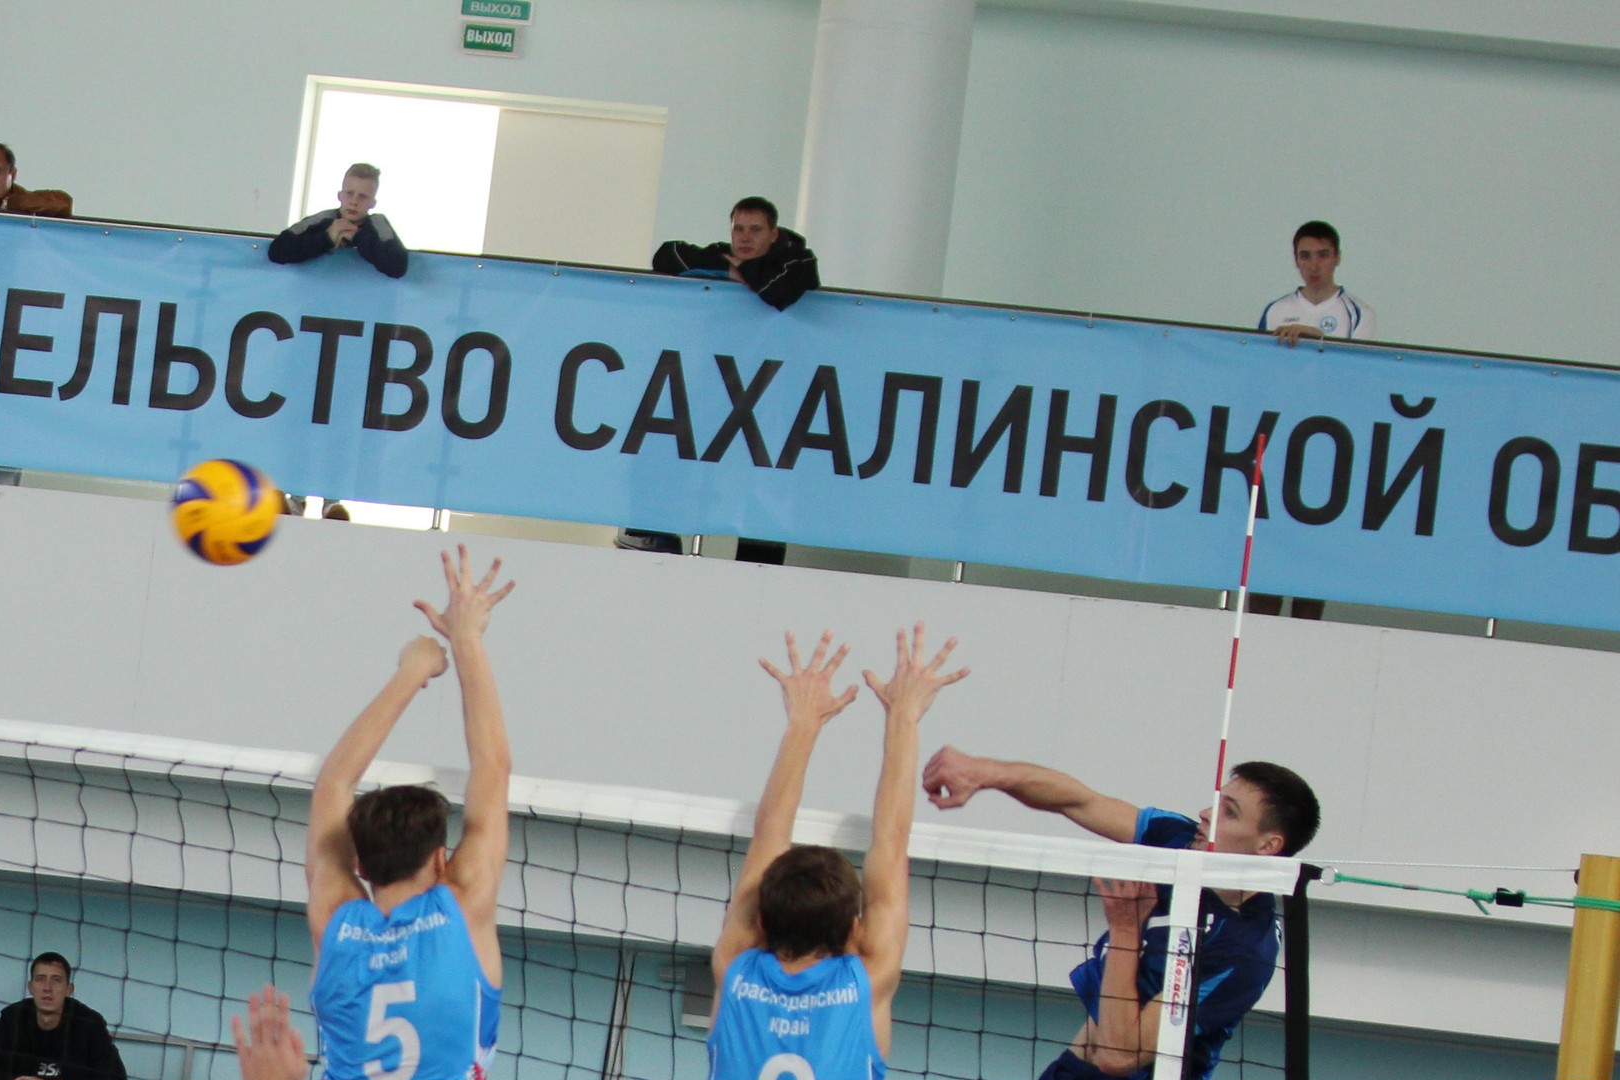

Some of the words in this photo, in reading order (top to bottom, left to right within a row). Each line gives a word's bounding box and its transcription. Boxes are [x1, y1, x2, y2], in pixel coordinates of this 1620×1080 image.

[470, 1, 521, 17] ВЫХОД
[466, 29, 513, 47] ВЫХОД
[553, 341, 1447, 537] САХАЛИНСКОЙ
